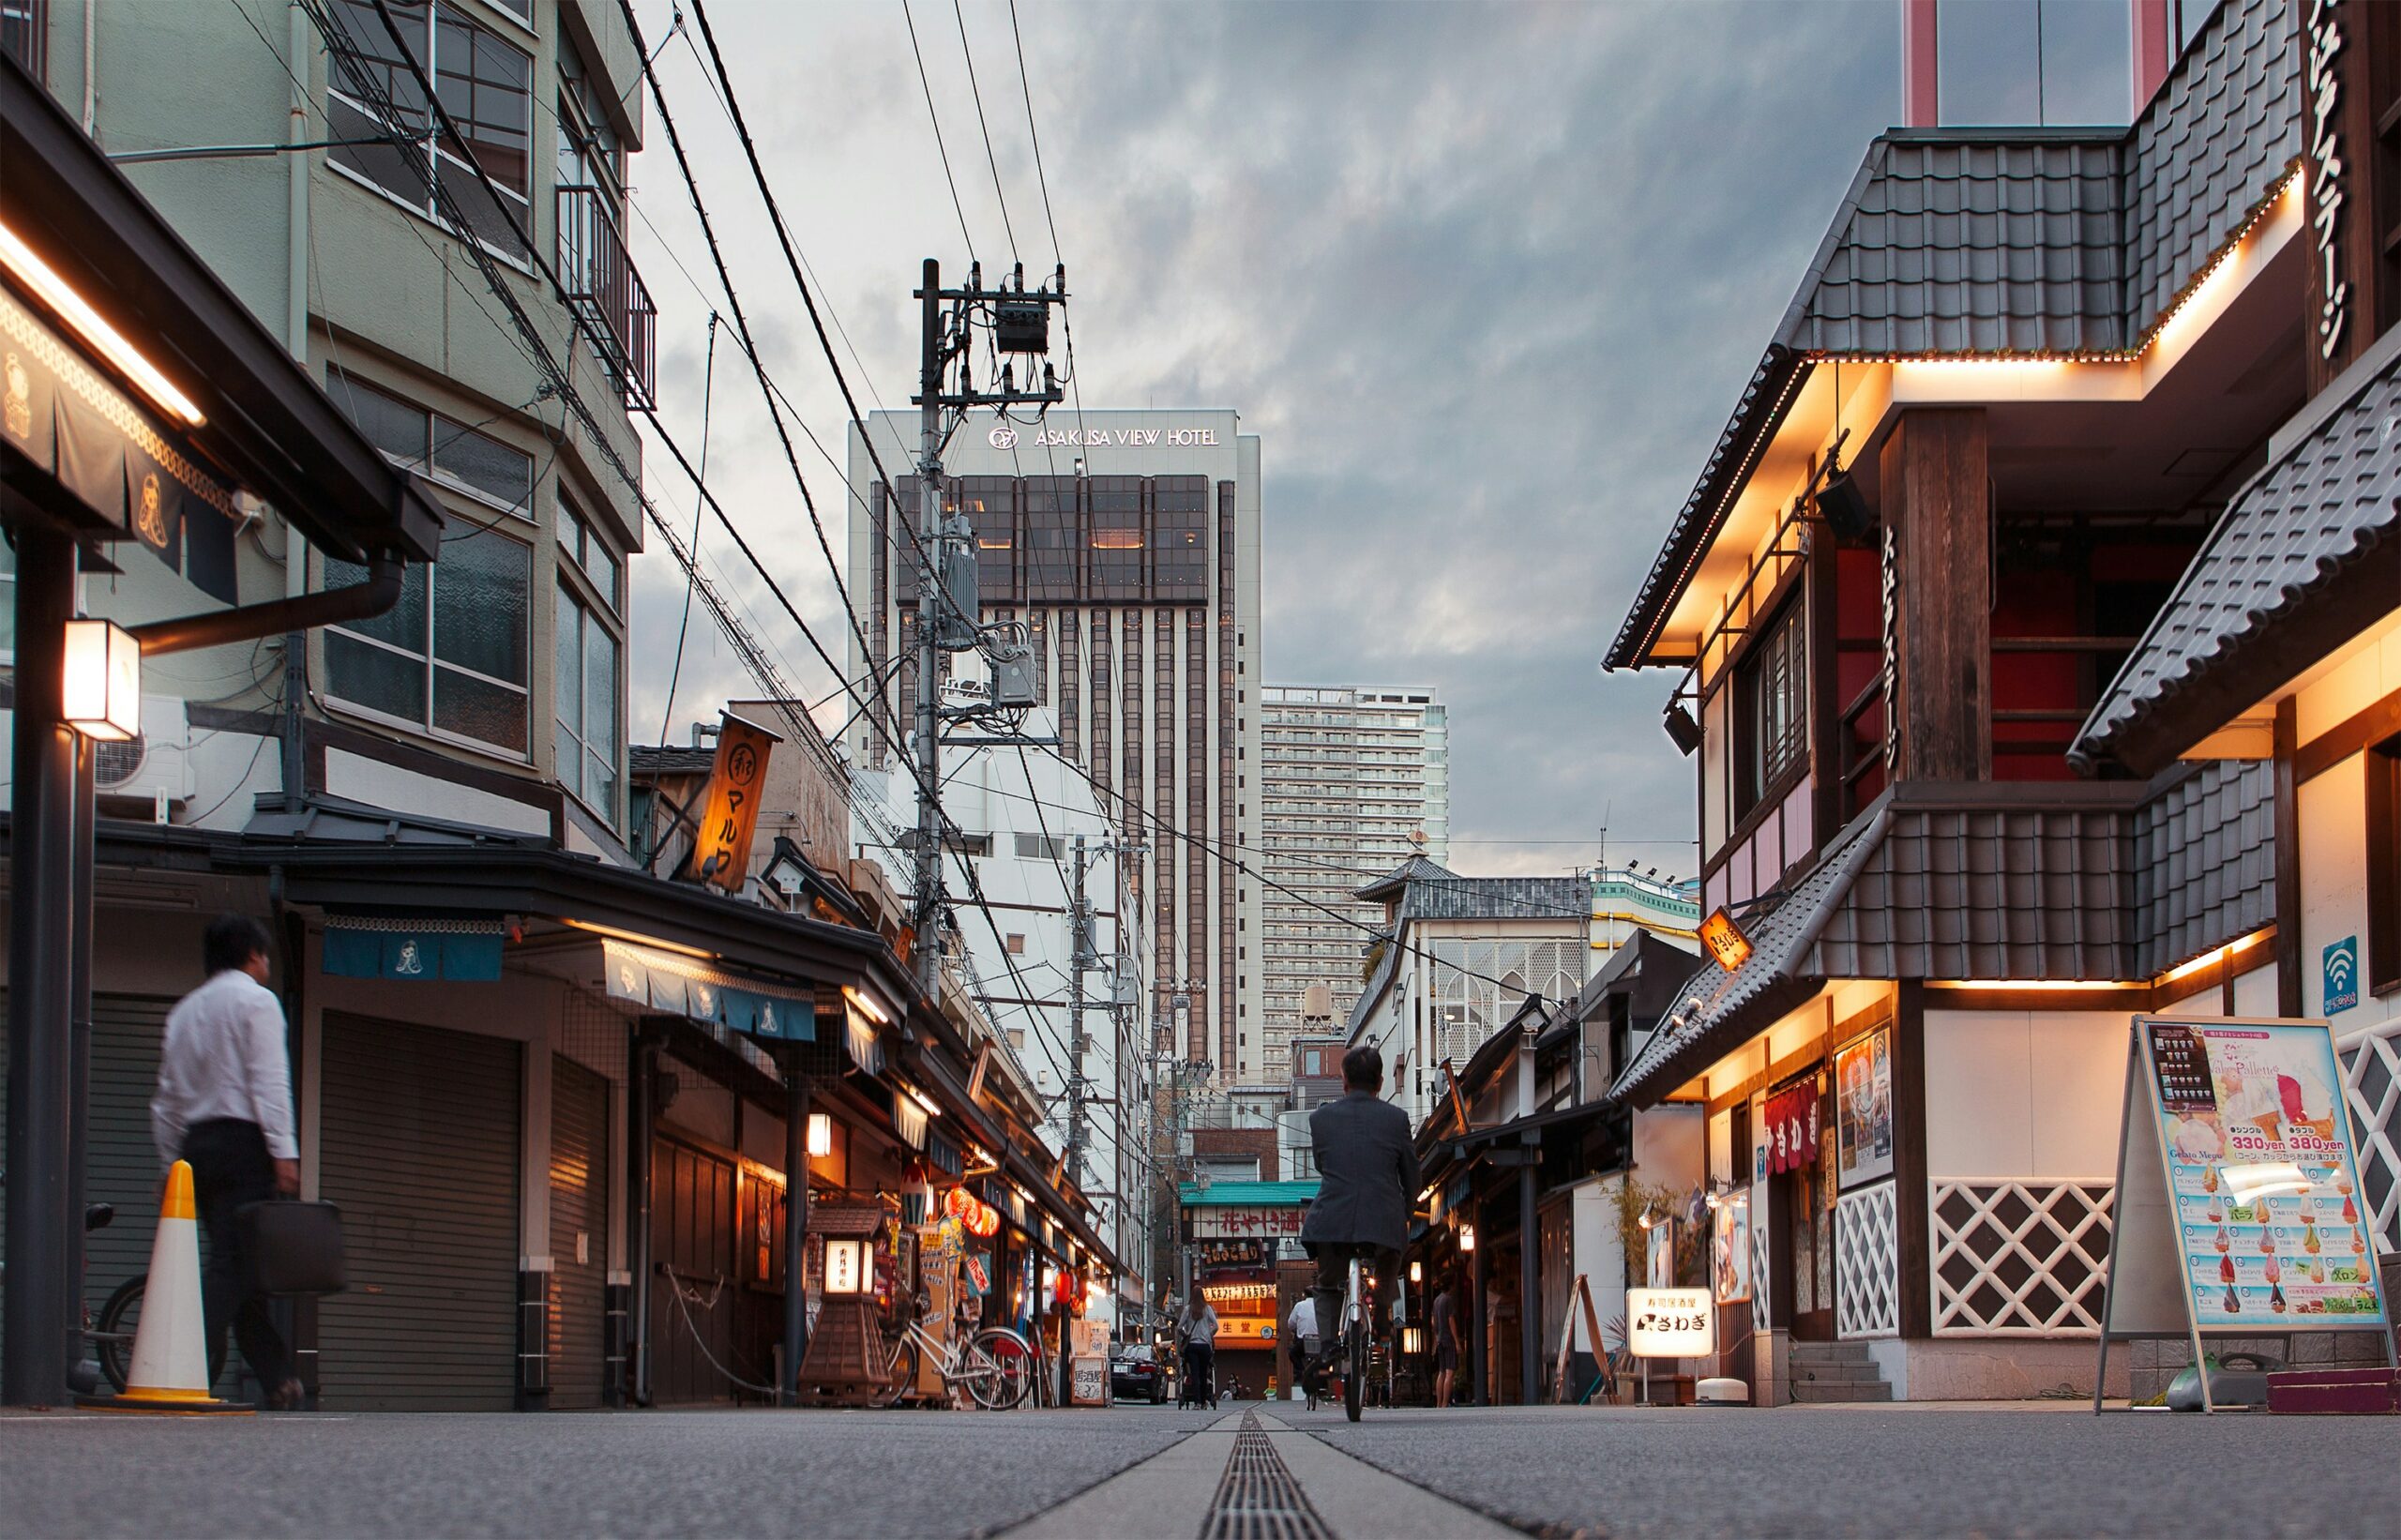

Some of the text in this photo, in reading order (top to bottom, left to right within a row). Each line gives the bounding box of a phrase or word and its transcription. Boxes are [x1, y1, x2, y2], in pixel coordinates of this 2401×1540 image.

[1034, 429, 1220, 446] ASAKUSA VIEW HOTEL
[1881, 524, 1897, 770] 大江戸ステージ
[2232, 1137, 2286, 1151] 330yen
[2289, 1137, 2345, 1151] 380yen
[2169, 1149, 2197, 1159] Gelato
[1657, 1313, 1707, 1332] さわぎ
[1075, 1370, 1101, 1383] 居酒屋
